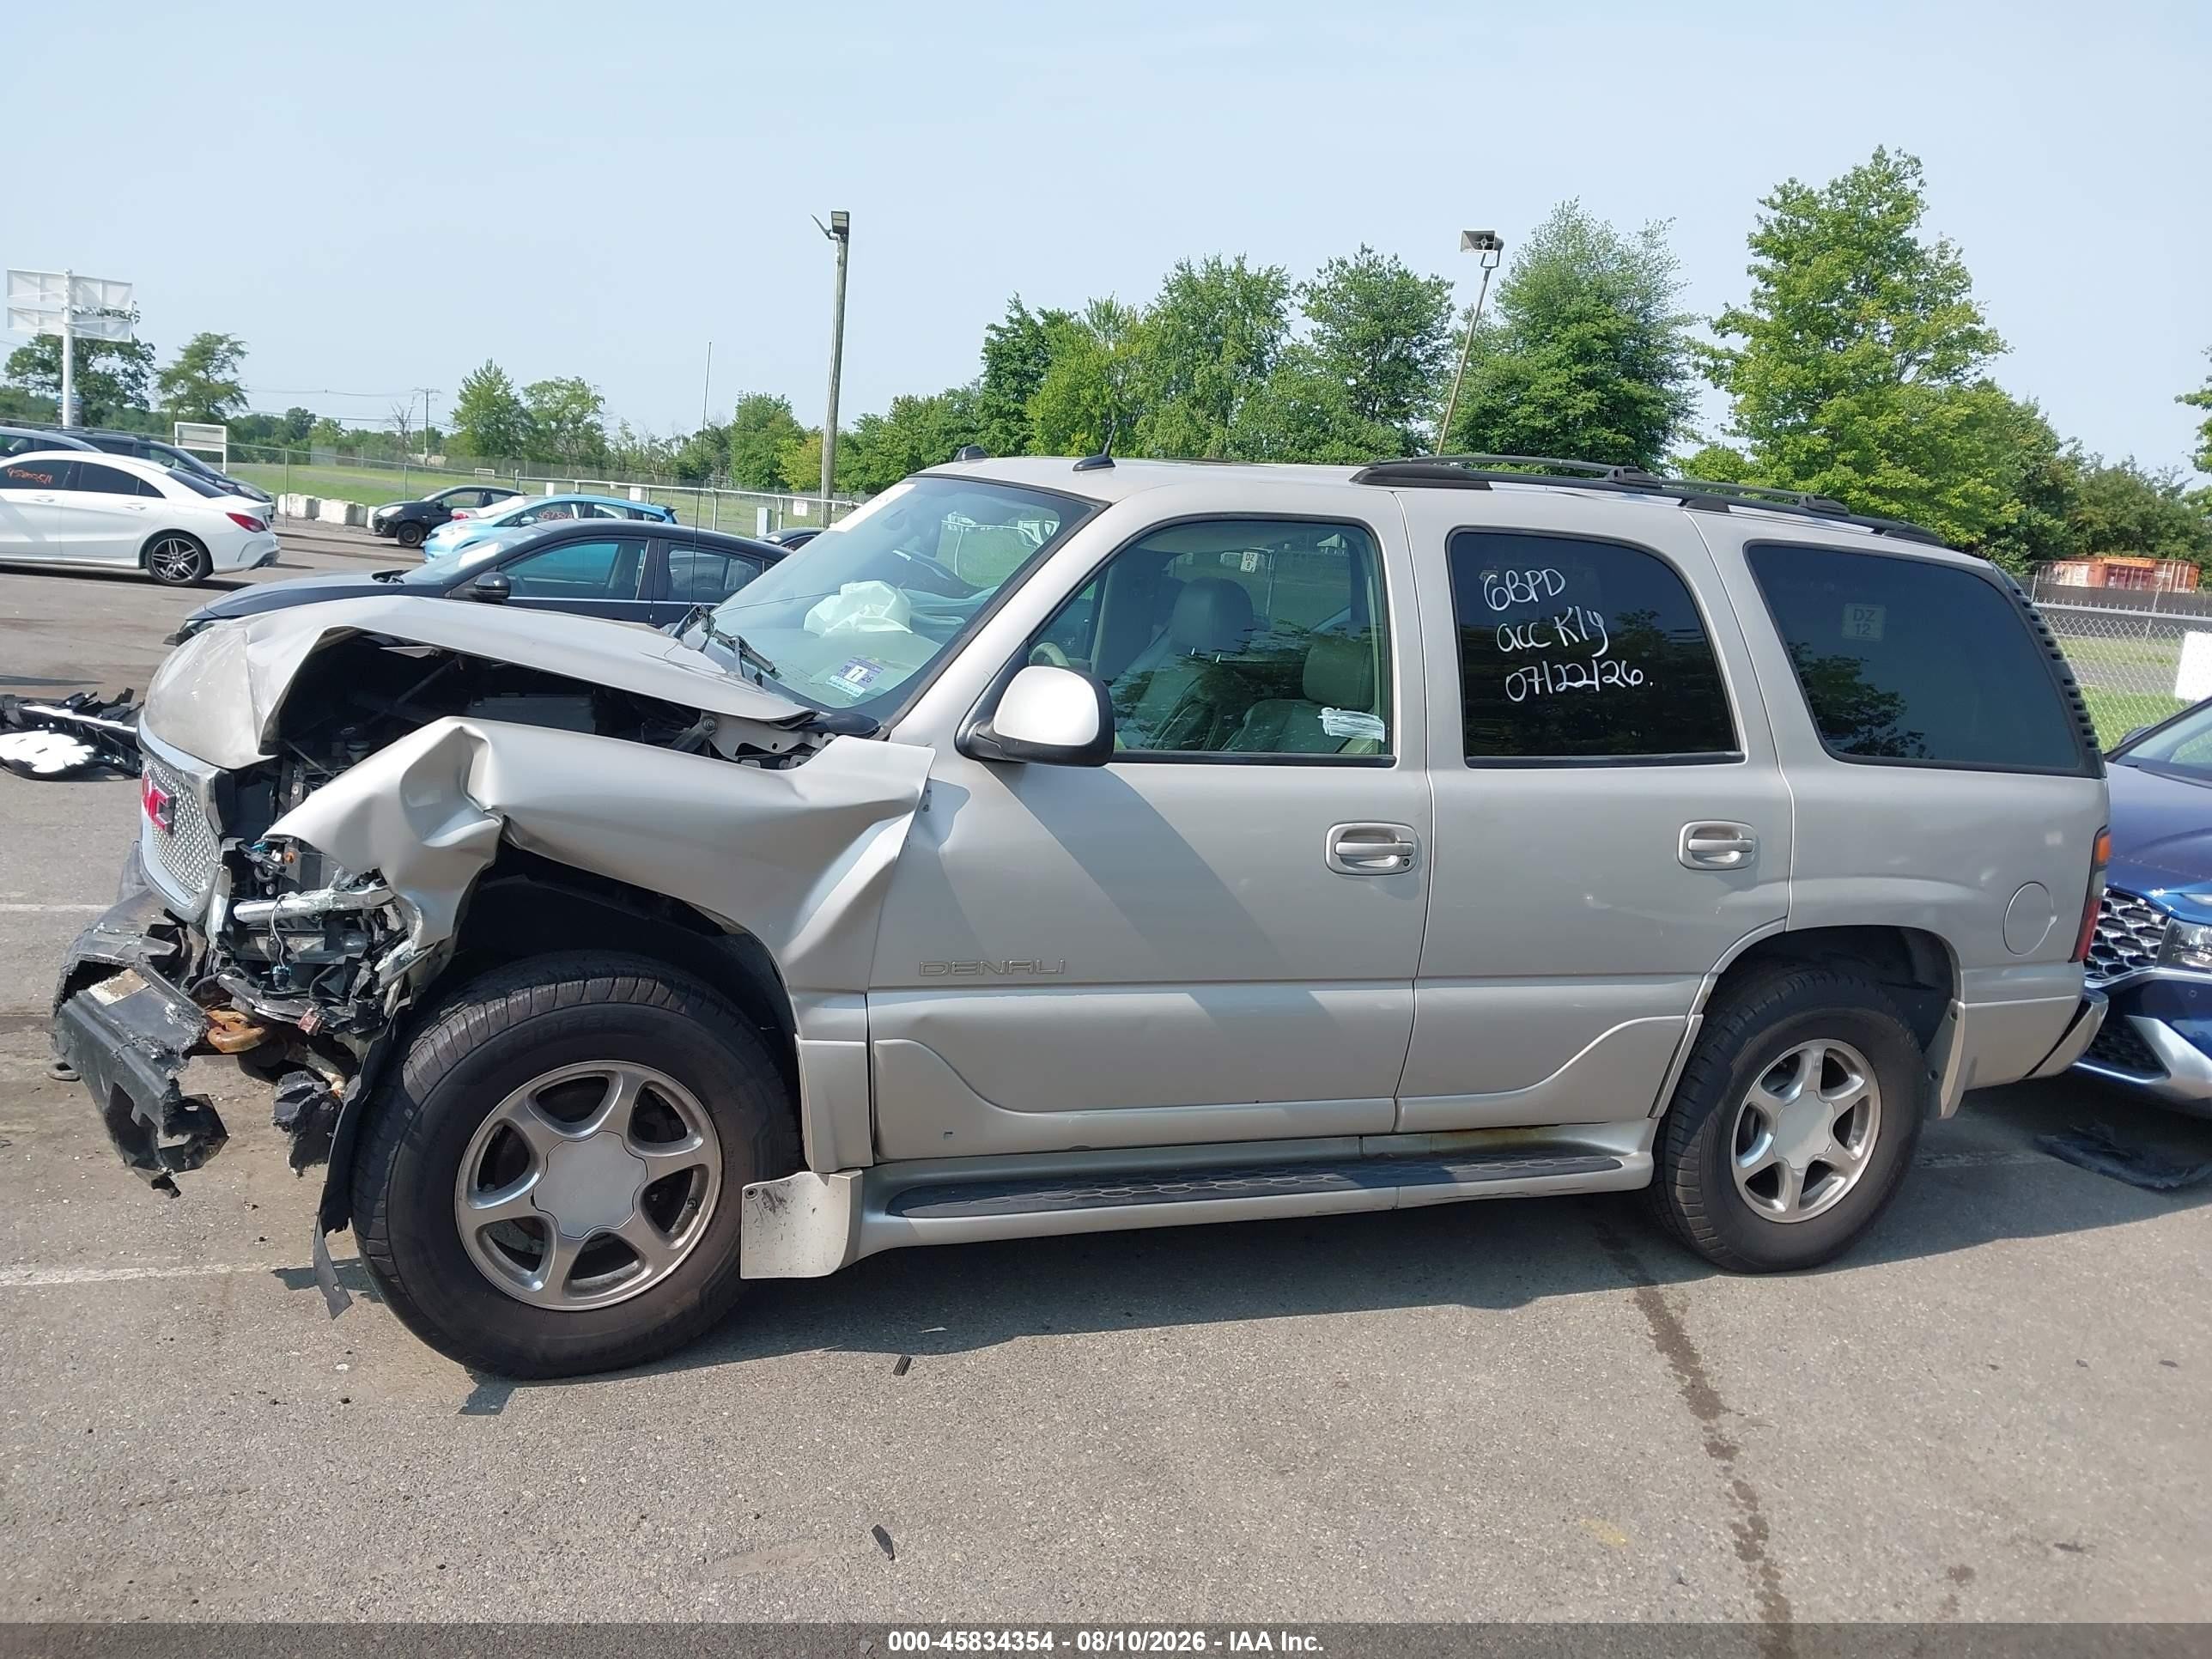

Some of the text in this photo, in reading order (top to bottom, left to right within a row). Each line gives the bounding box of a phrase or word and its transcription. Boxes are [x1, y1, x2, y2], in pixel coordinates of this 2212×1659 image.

[1245, 553, 1255, 562] DZ
[1853, 608, 1876, 622] DZ
[1856, 623, 1870, 635] 12
[850, 668, 863, 679] 7
[861, 674, 873, 684] 26
[920, 959, 1066, 976] DENALI
